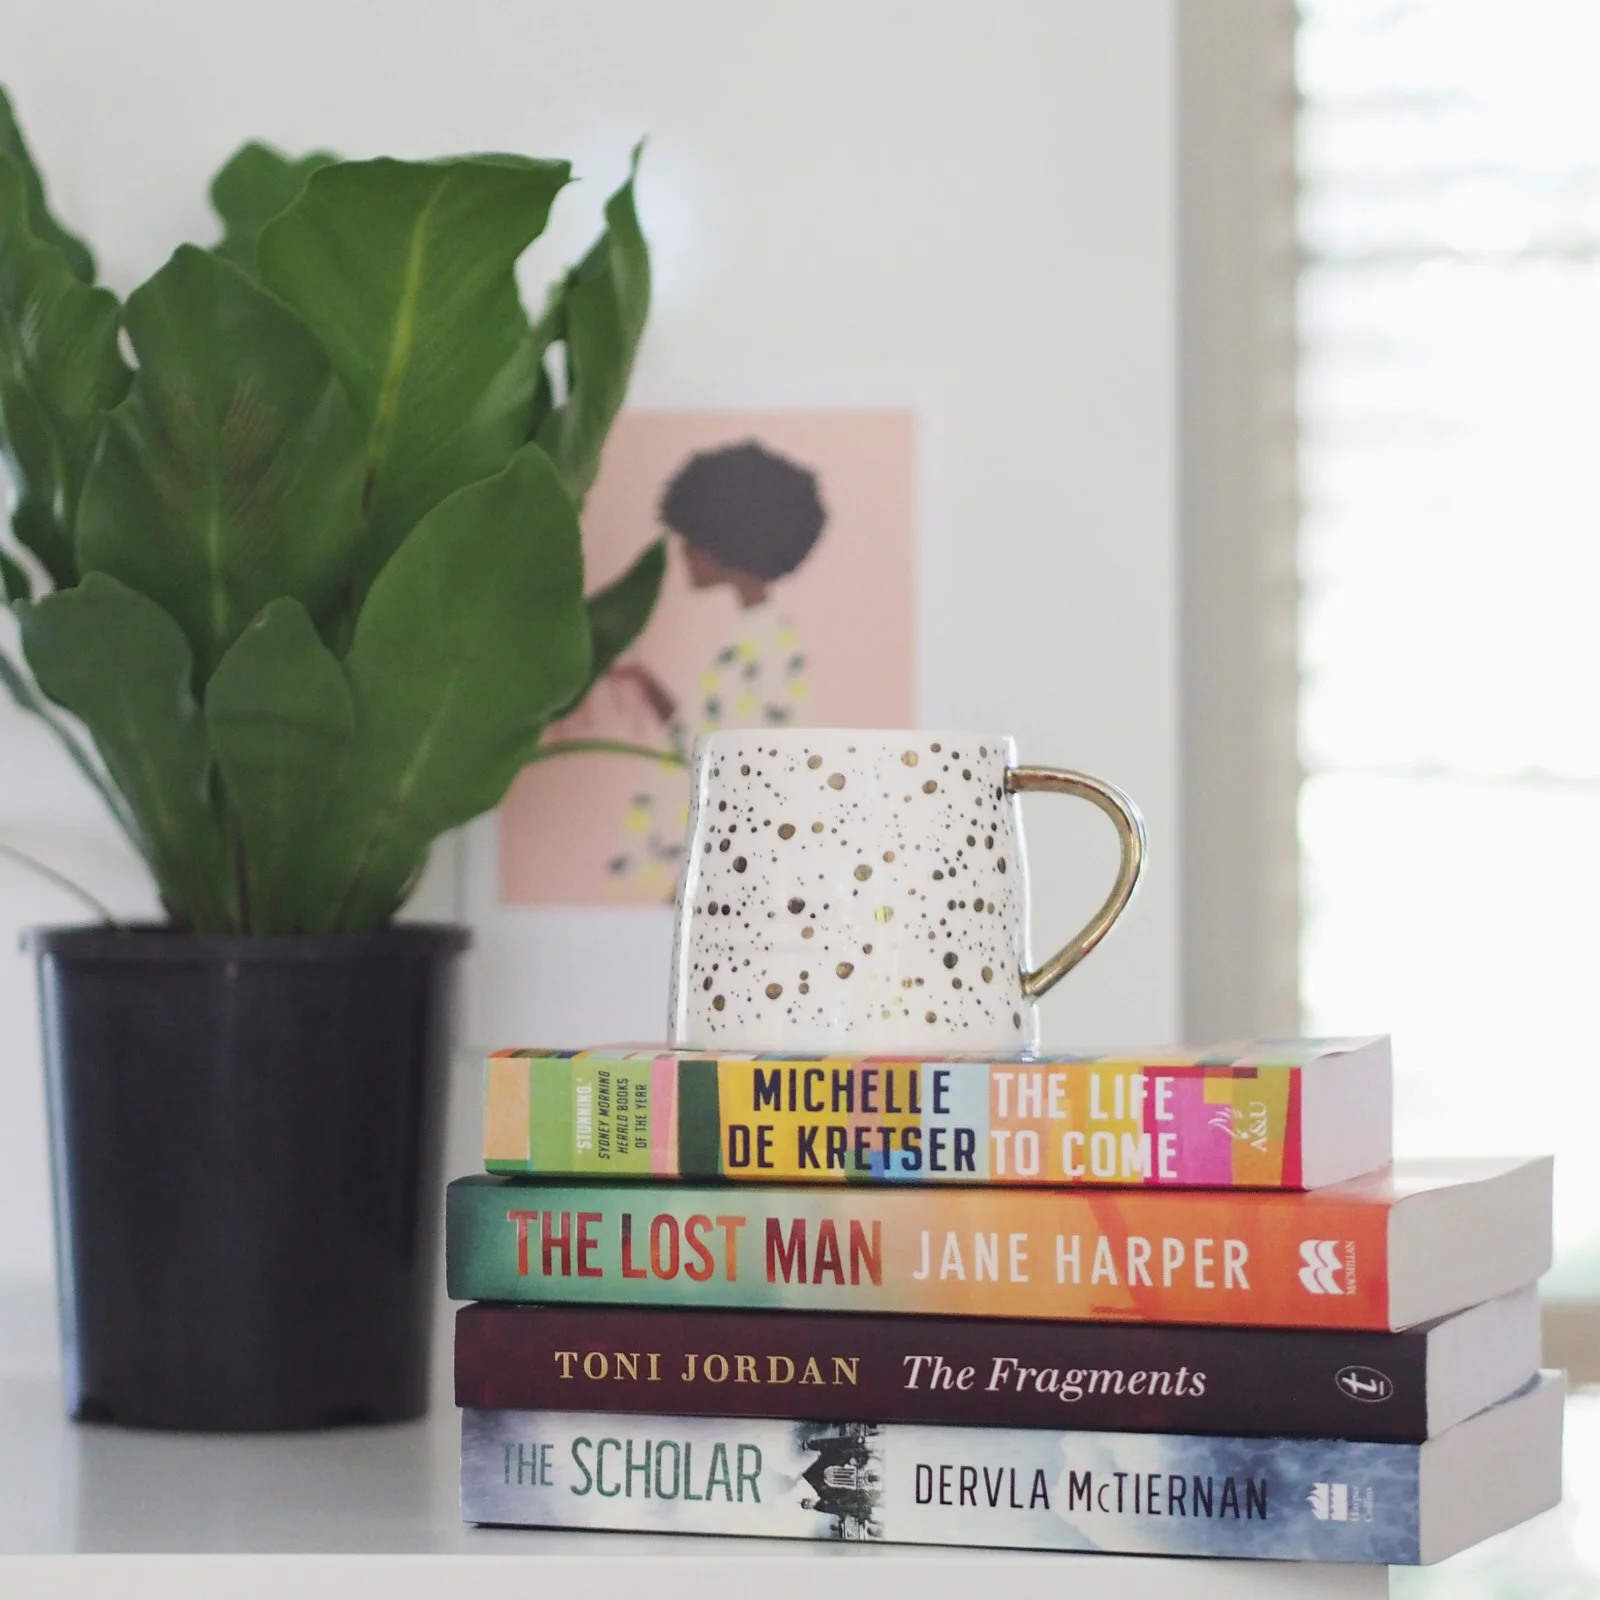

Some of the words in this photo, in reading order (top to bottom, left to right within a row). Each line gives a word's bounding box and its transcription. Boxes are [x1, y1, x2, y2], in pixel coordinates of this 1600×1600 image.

[598, 1070, 610, 1117] MORNING
[616, 1078, 629, 1111] BOOKS
[635, 1084, 647, 1110] YEAR
[752, 1067, 951, 1115] MICHELLE
[993, 1071, 1066, 1119] THE
[1089, 1073, 1174, 1121] LIFE
[598, 1119, 610, 1160] SYDNEY
[616, 1114, 629, 1154] HERALD
[635, 1114, 647, 1132] THE
[635, 1138, 647, 1149] OF
[1249, 1101, 1267, 1153] A&U
[728, 1124, 774, 1168] DE
[797, 1126, 976, 1172] KRETSER
[990, 1129, 1040, 1176] TO
[1062, 1130, 1178, 1179] COME
[507, 1209, 603, 1278] THE
[621, 1212, 746, 1282] LOST
[765, 1217, 883, 1287] MAN
[912, 1230, 1029, 1282] JANE
[1056, 1234, 1250, 1290] HARPER
[1345, 1240, 1356, 1294] MACMILLAN
[554, 1351, 662, 1381] TONI
[681, 1353, 861, 1386] JORDAN
[902, 1355, 975, 1391] The
[984, 1357, 1207, 1402] Fragments
[501, 1442, 555, 1487] THE
[570, 1436, 763, 1504] SCHOLAR
[915, 1463, 1051, 1510] DERVLA
[1068, 1470, 1269, 1520] McTIERNAN
